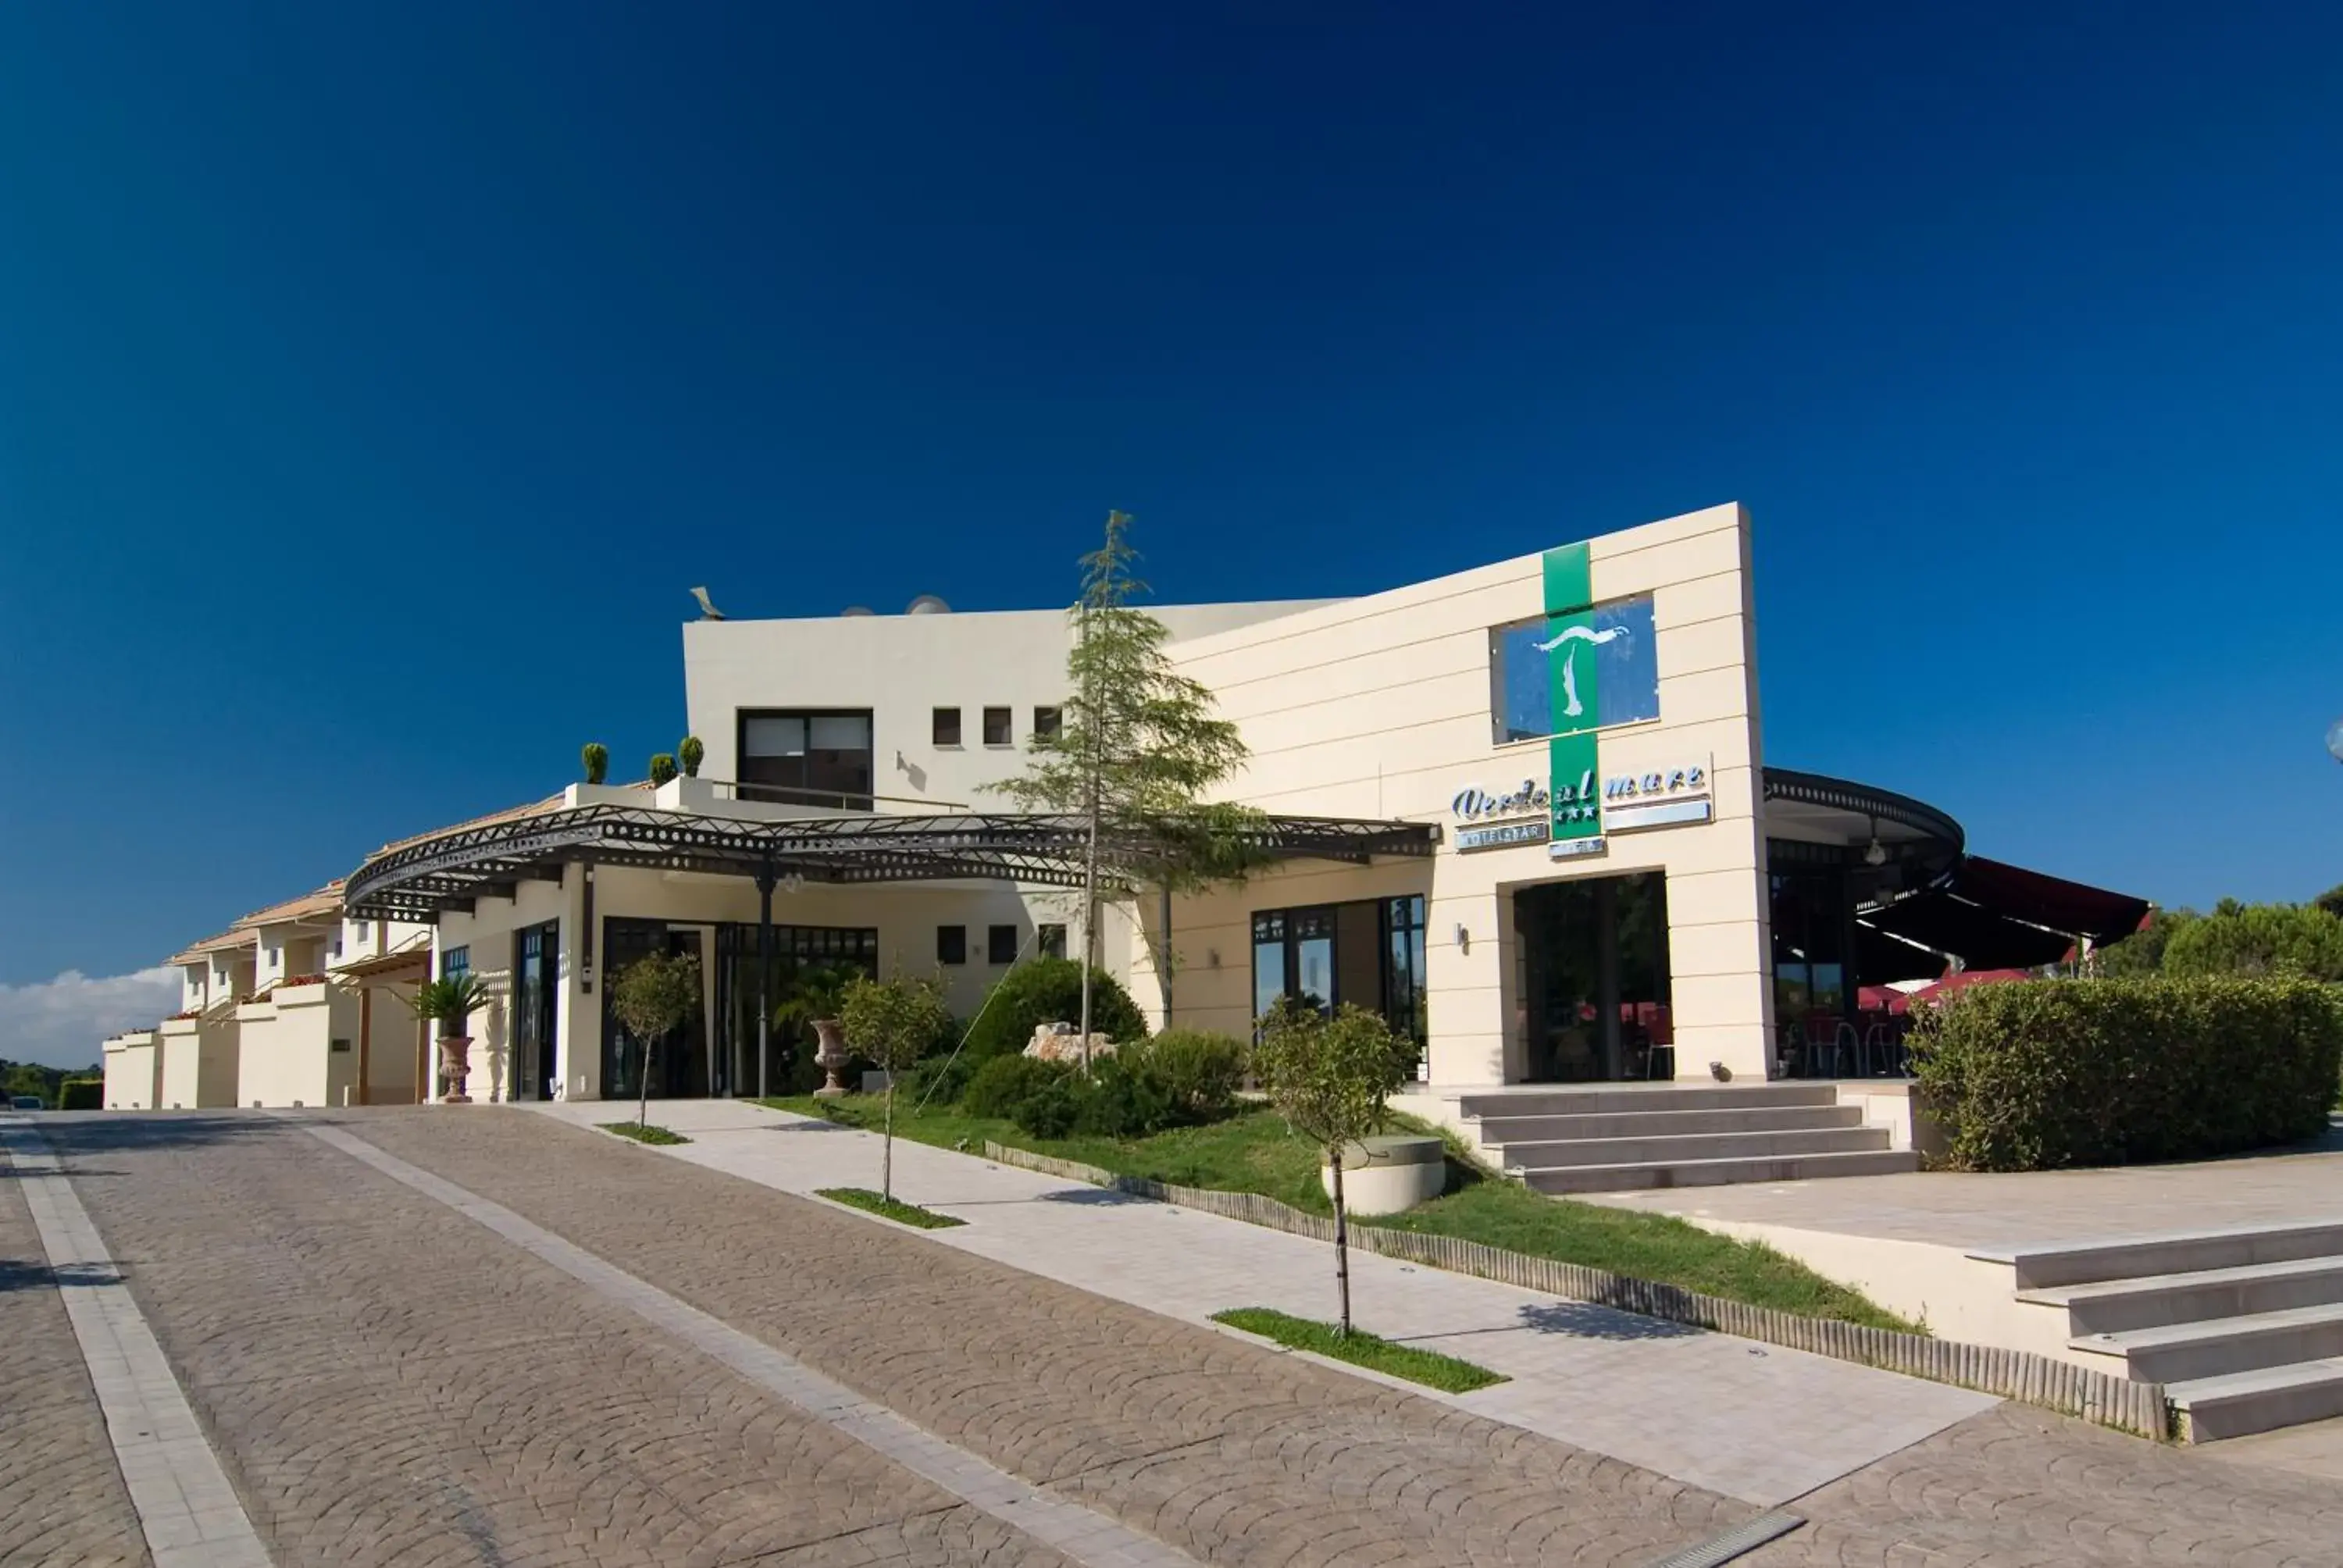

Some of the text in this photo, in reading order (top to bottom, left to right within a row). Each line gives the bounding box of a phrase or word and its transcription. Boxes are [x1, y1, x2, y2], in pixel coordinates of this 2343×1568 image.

[1453, 764, 1706, 819] Verde al mare
